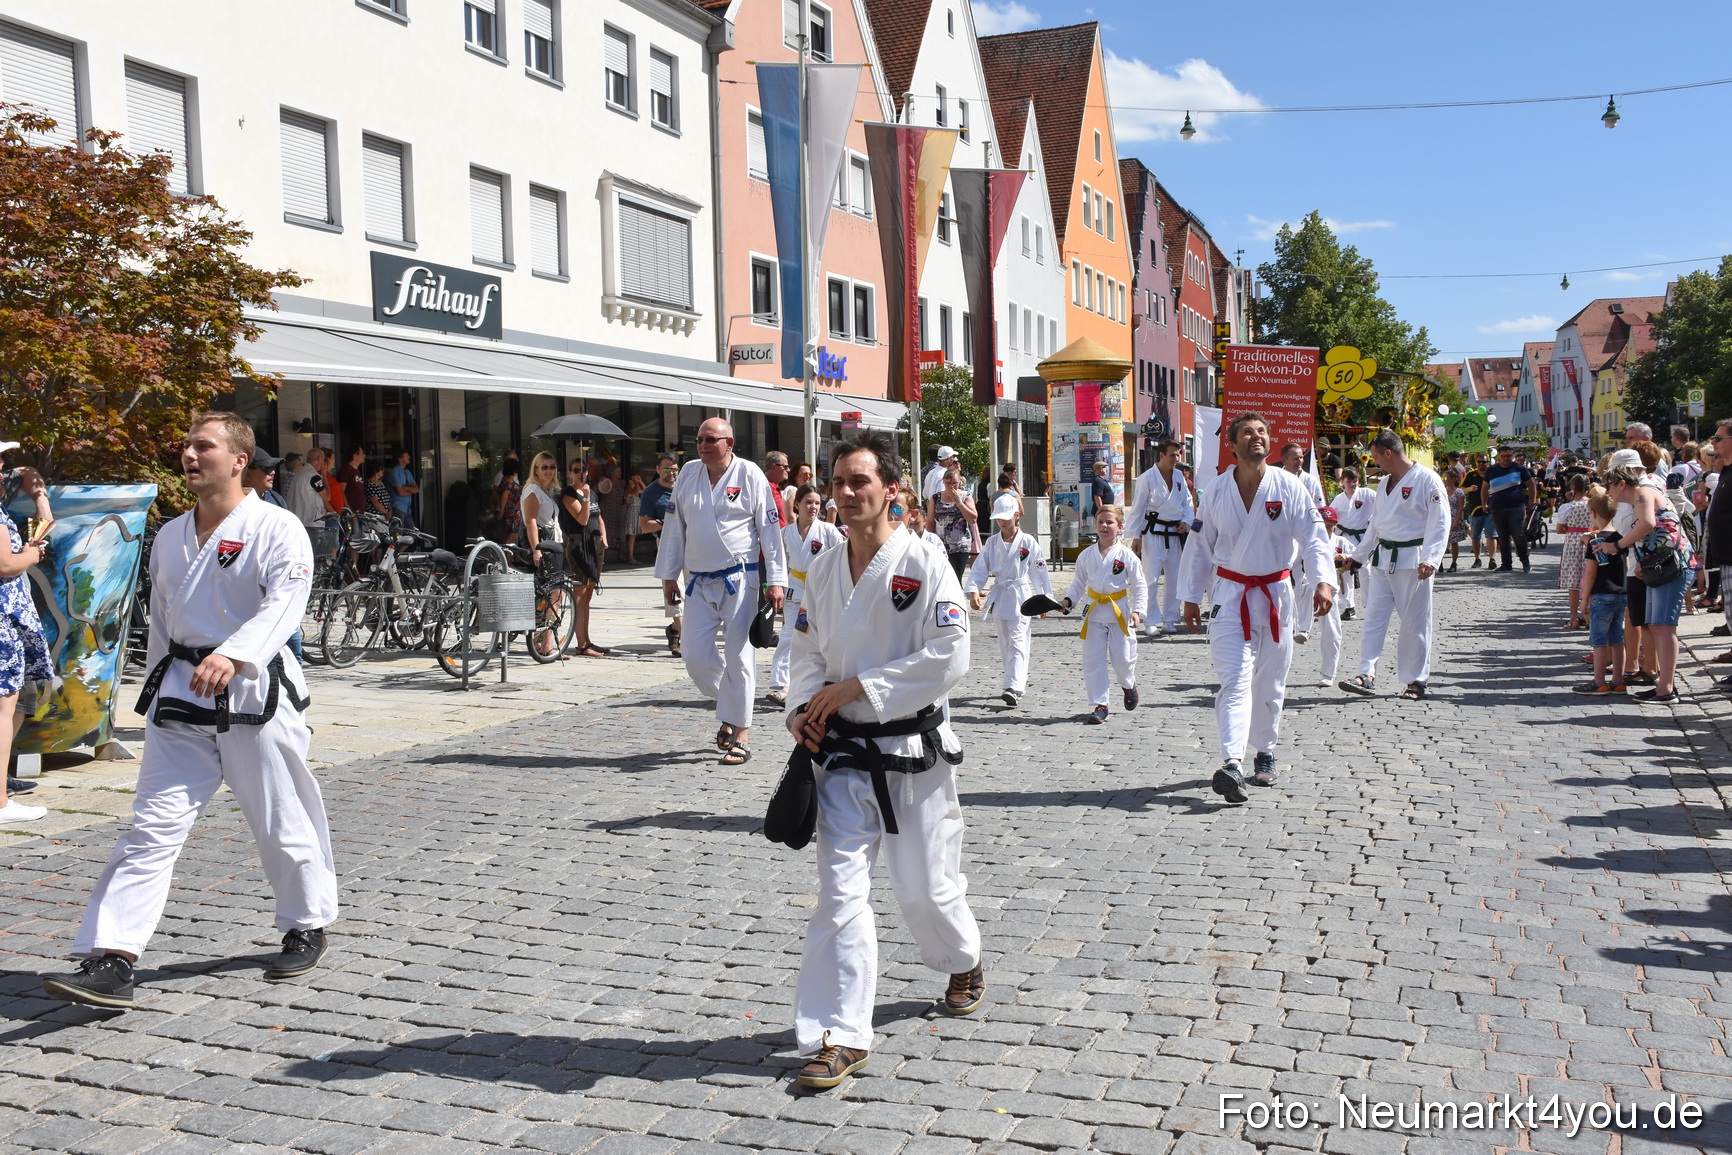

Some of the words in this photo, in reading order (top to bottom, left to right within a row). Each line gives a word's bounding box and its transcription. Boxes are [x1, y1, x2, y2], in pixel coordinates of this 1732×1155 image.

[382, 265, 499, 329] frühauf
[732, 347, 772, 361] sutor.
[1231, 349, 1315, 364] Traditionelles
[1232, 361, 1312, 376] Taekwon-Do
[1261, 376, 1297, 385] Neumarkt
[1334, 369, 1354, 385] 50
[1257, 392, 1311, 401] Selbstverteidigung
[1271, 401, 1311, 409] Konzentration
